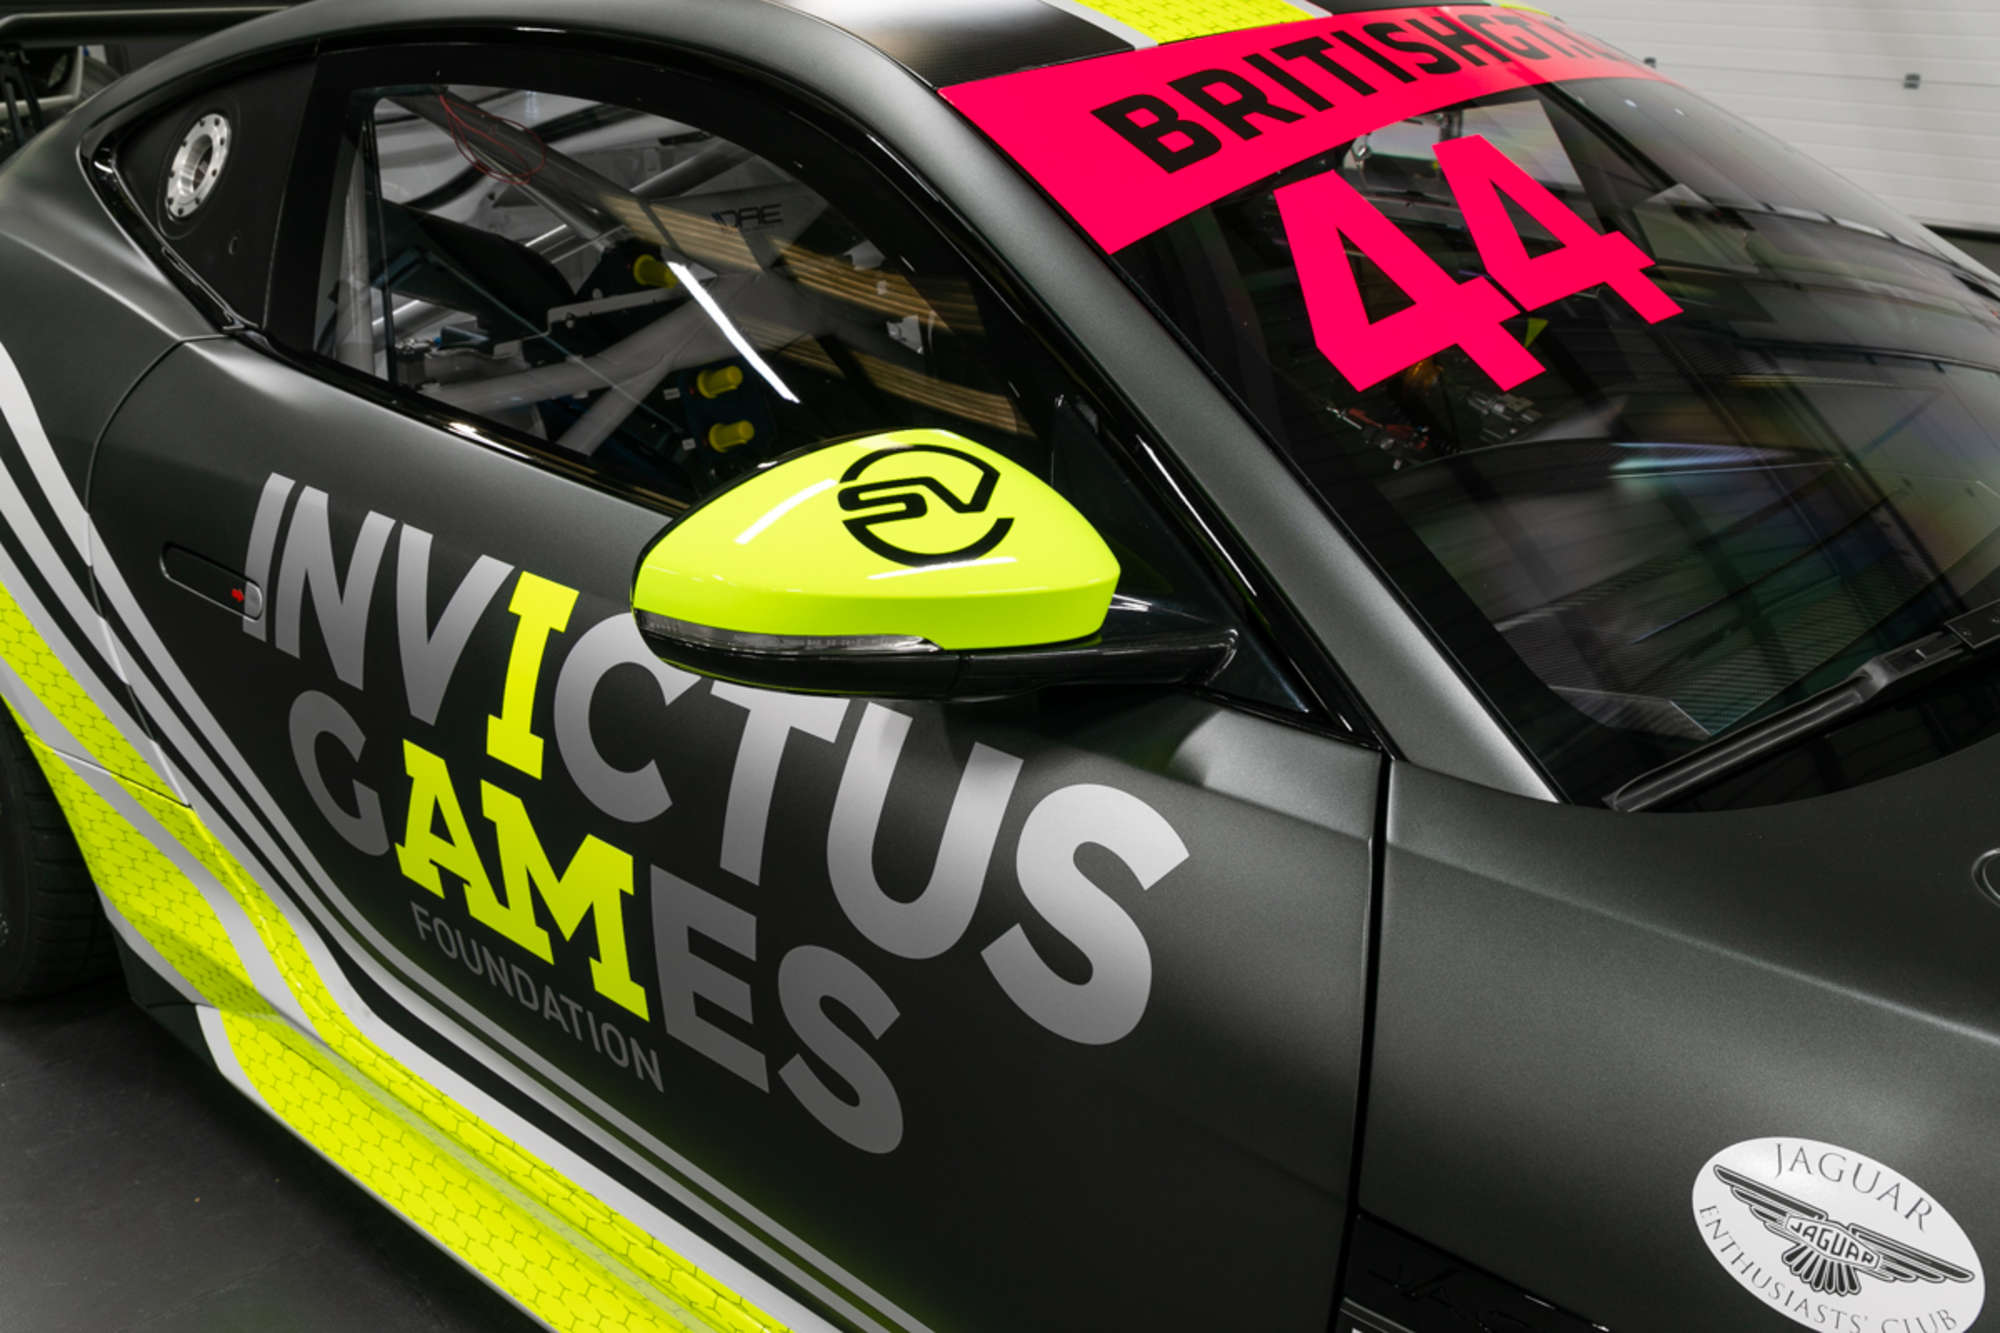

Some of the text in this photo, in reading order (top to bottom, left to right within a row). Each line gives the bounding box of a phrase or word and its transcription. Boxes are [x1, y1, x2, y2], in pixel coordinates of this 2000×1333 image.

[1275, 134, 1683, 392] 44
[242, 471, 1190, 1045] INVICTUS
[288, 689, 904, 1155] GAMES
[410, 902, 664, 1092] FOUNDATION
[1776, 1142, 1933, 1233] JAGUAR
[1789, 1221, 1875, 1265] JAGUAR
